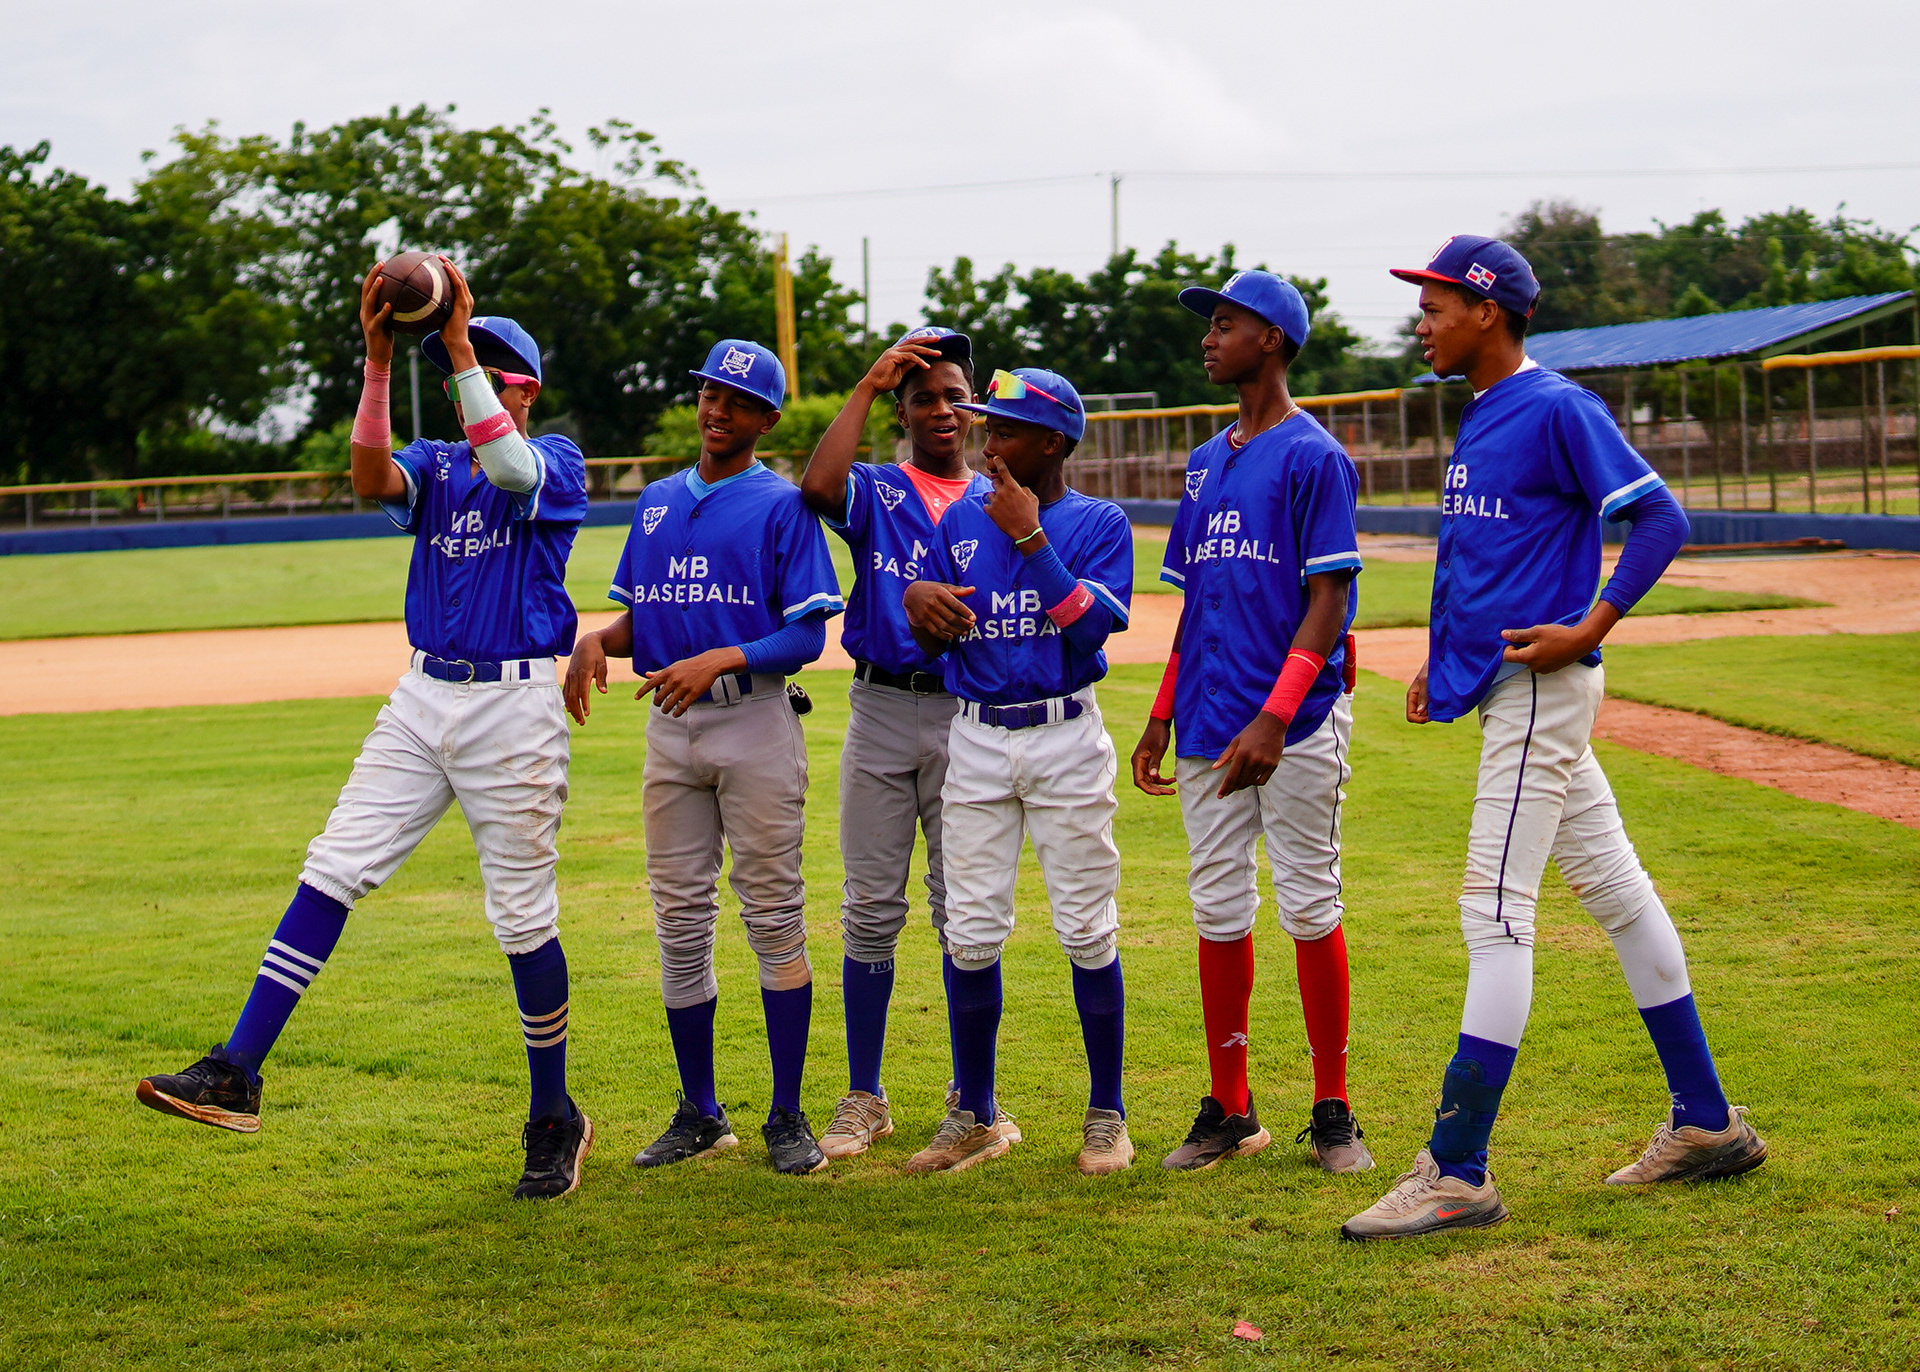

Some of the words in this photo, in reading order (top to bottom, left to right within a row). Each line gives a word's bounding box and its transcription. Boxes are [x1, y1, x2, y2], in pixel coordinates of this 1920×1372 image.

[668, 556, 709, 580] MB
[634, 583, 755, 606] BASEBALL
[991, 589, 1042, 614] MB
